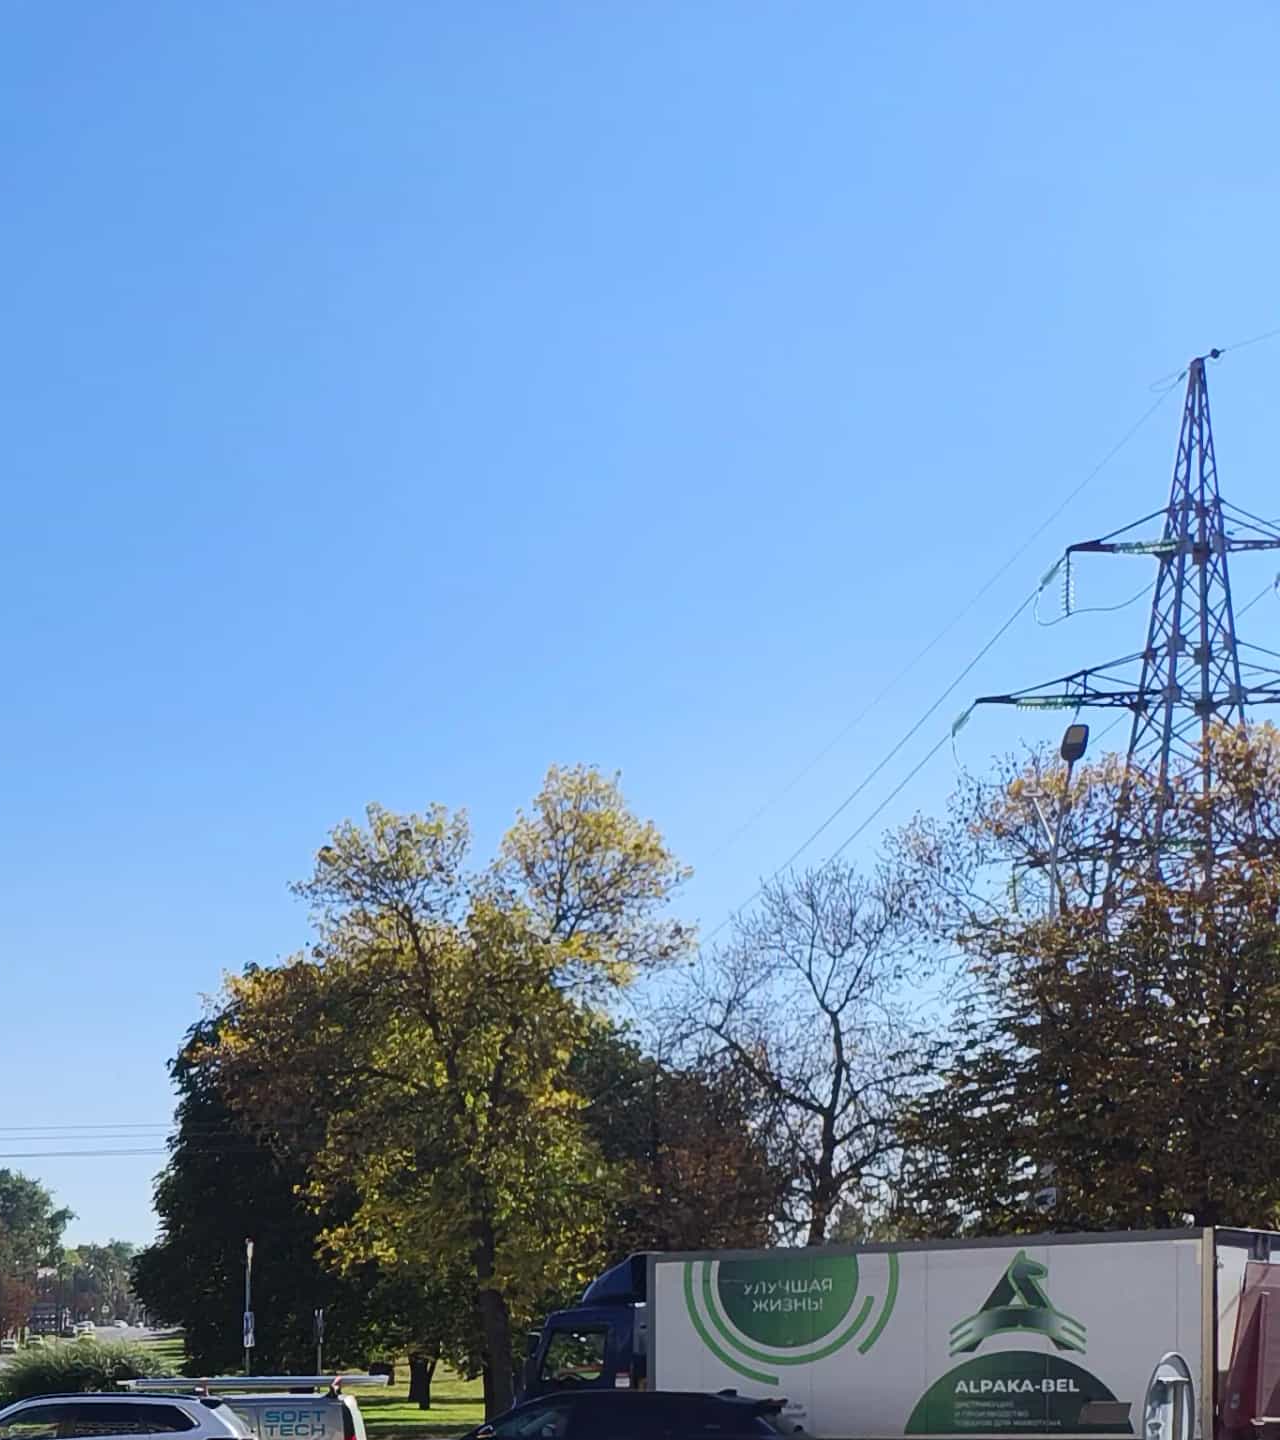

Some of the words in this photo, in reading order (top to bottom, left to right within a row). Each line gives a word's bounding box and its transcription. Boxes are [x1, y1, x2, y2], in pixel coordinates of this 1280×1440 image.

[743, 1278, 833, 1295] УЛУЧШАЯ
[955, 1379, 1080, 1393] ALPAKA-BEL
[264, 1410, 327, 1423] SOFT
[264, 1424, 326, 1437] TECH
